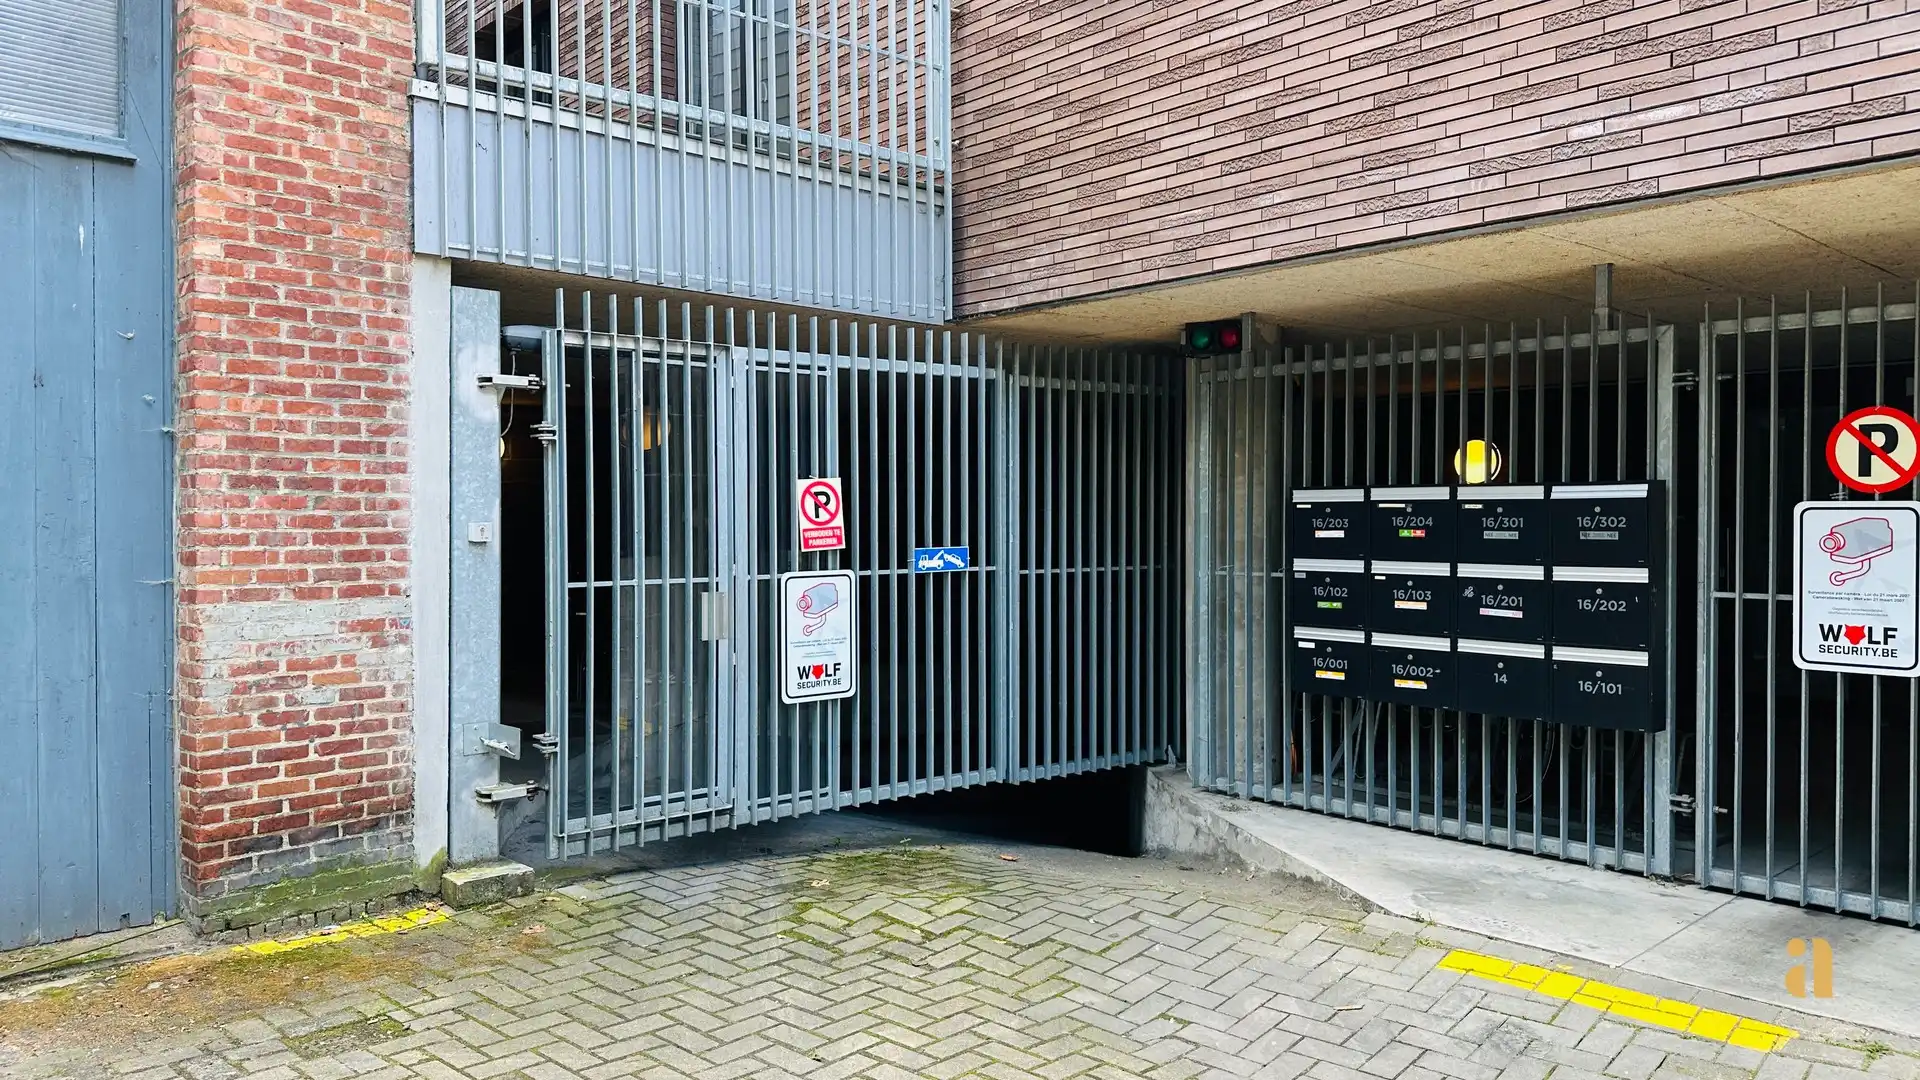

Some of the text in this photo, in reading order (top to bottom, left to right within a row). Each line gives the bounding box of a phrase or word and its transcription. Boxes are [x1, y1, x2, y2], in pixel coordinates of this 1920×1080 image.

[1858, 423, 1899, 478] P
[813, 491, 831, 518] P
[1312, 517, 1349, 529] 16/203
[1391, 515, 1433, 528] 16/204
[1481, 515, 1524, 530] 16/301
[1576, 515, 1627, 530] 16/302
[1312, 585, 1348, 598] 16/102
[1392, 588, 1432, 602] 16/103
[1480, 594, 1523, 608] 16/201
[1577, 598, 1627, 612] 16/202
[1818, 643, 1898, 659] SECURITY.BE
[1312, 657, 1348, 670] 16/001
[1391, 663, 1434, 678] 16/002
[796, 678, 842, 690] SECURITY.BE
[1493, 672, 1508, 684] 14
[1577, 680, 1622, 695] 16/101
